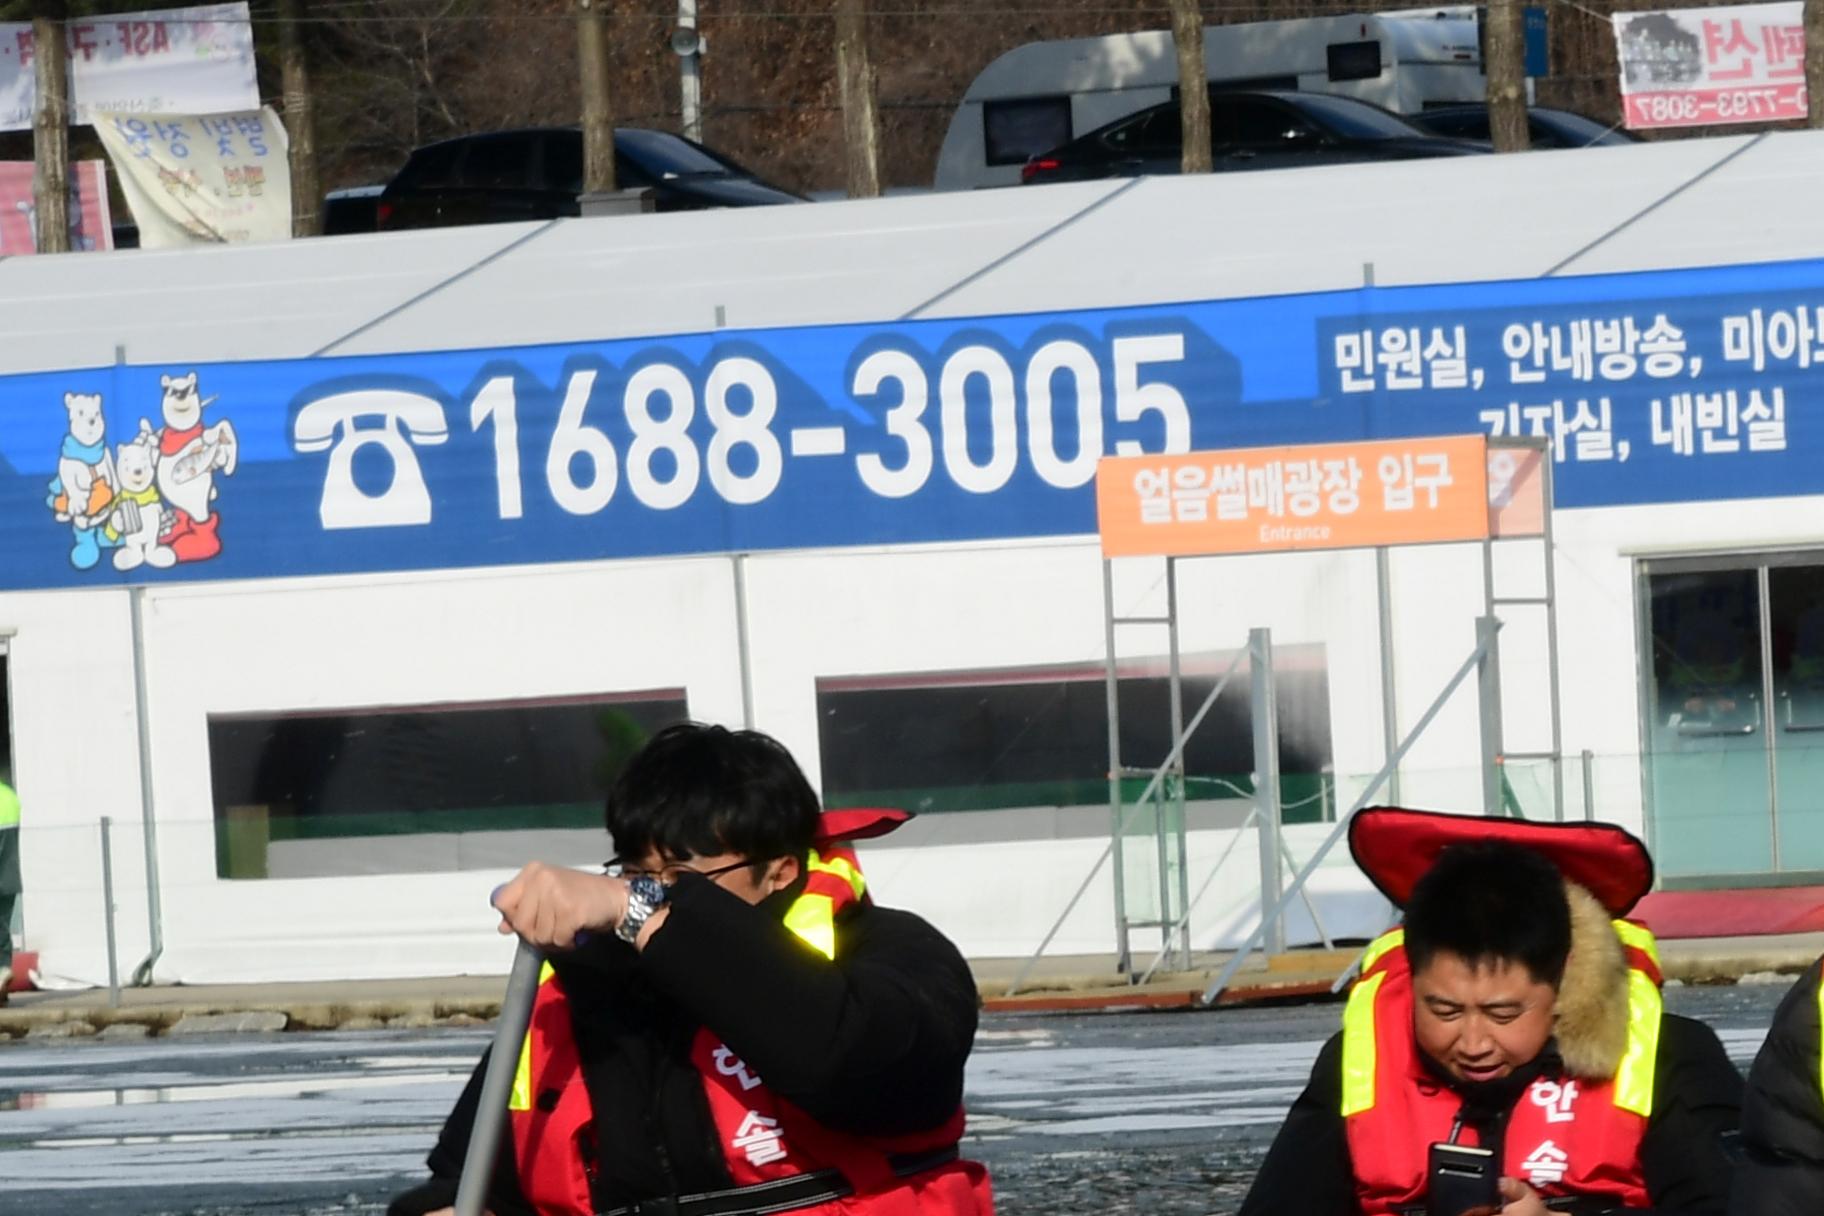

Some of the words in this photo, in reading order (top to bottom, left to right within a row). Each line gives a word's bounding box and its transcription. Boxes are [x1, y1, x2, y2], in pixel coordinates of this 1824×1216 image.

[1335, 326, 1484, 392] 민원실,
[1503, 315, 1702, 382] 안내방송,
[469, 334, 1191, 519] 1688-3005
[1651, 388, 1786, 455] 내빈실
[1133, 466, 1363, 524] 얼음썰매광장
[1376, 452, 1455, 511] 입구
[1258, 523, 1331, 544] Entrance
